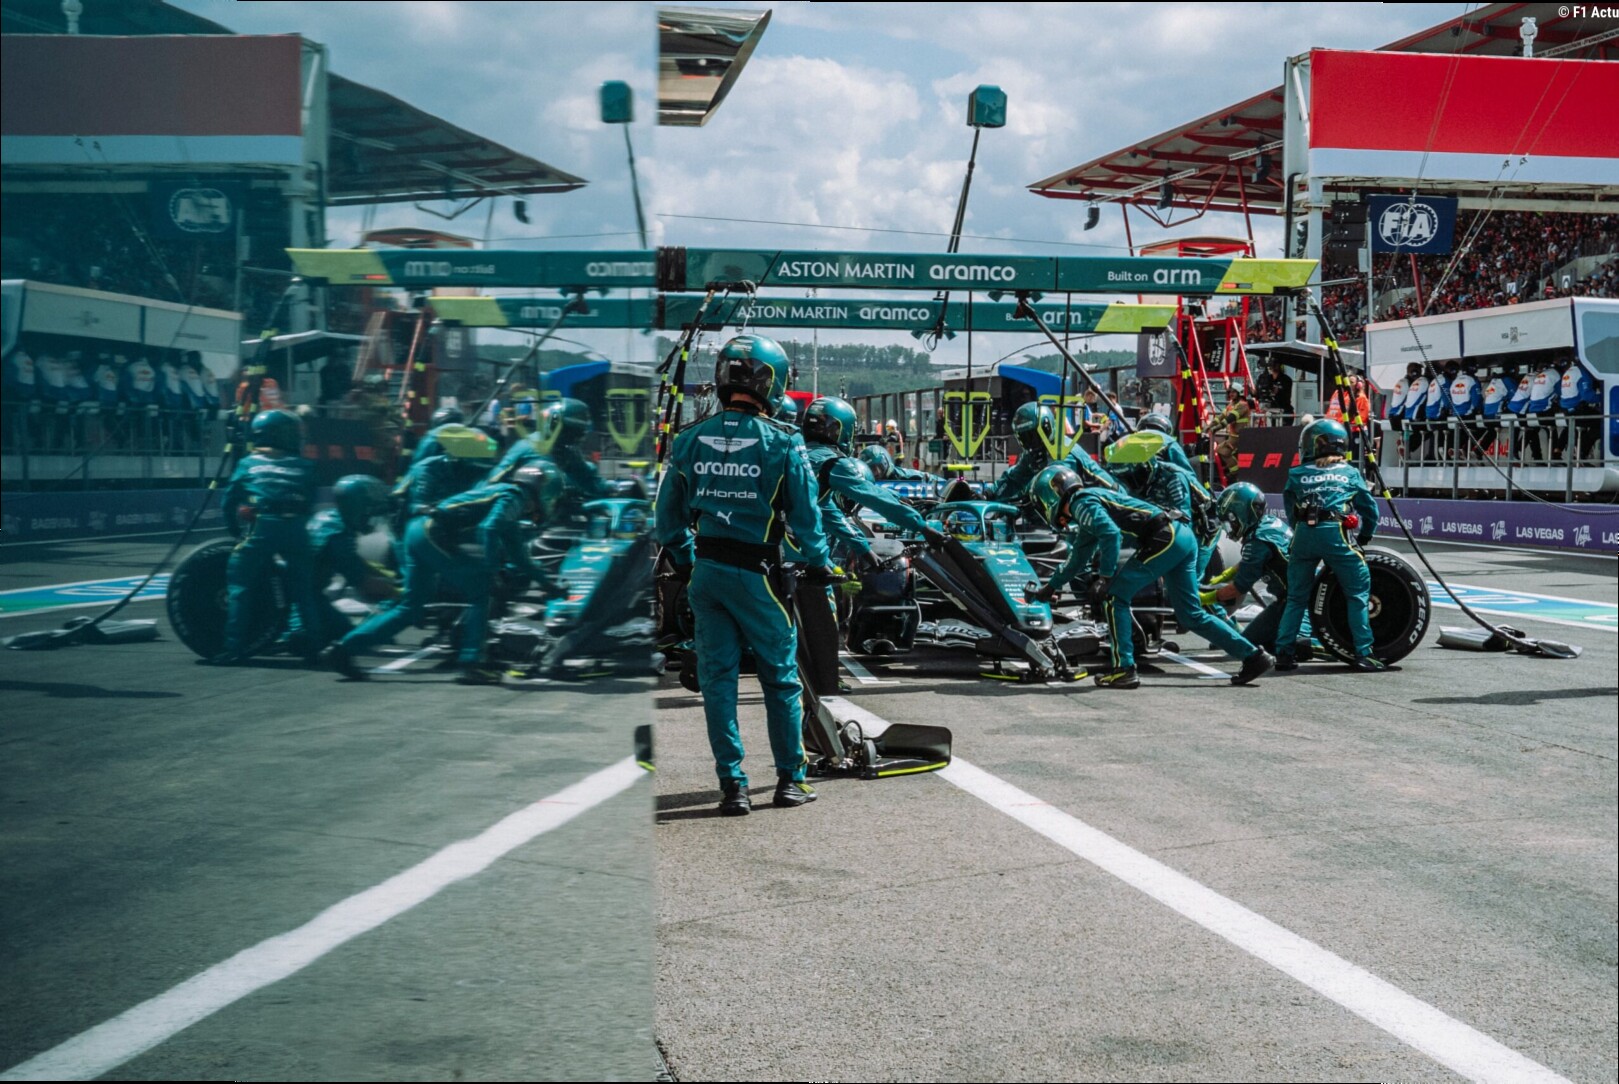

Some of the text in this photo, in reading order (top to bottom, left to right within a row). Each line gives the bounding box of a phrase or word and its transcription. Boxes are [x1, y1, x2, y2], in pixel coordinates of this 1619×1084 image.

[778, 261, 915, 279] ASTON MARTIN
[929, 264, 1016, 281] aramco
[1107, 268, 1201, 285] Built on arm
[737, 305, 848, 320] ASTON MARTIN
[859, 306, 930, 321] aramco
[1042, 311, 1082, 325] arm
[693, 461, 762, 478] aramco
[1300, 473, 1349, 485] aramco
[706, 489, 757, 499] Honda
[1441, 521, 1457, 533] LAS
[1457, 522, 1483, 535] VEGAS
[1516, 526, 1533, 539] LAS
[1534, 528, 1564, 541] VEGAS
